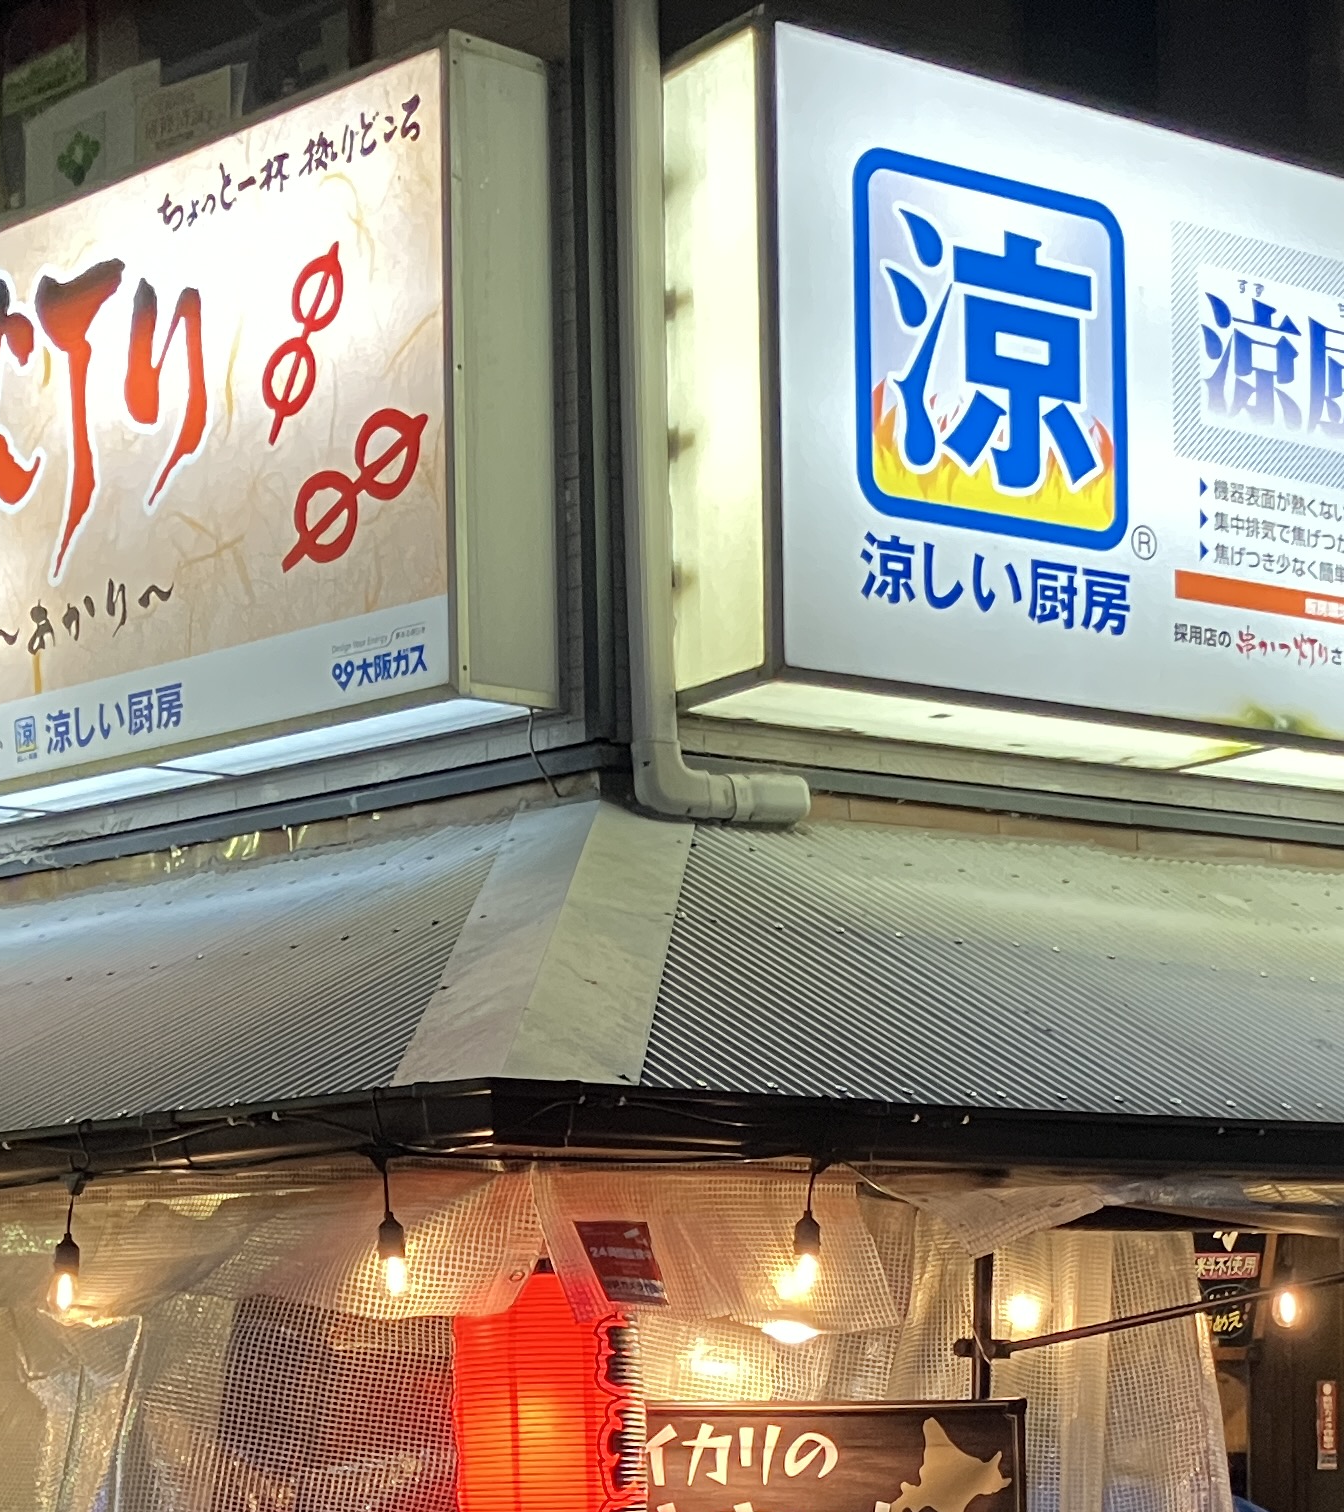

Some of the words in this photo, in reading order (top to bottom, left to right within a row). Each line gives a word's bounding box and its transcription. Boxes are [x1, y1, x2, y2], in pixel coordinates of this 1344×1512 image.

[882, 208, 1099, 489] 涼
[859, 532, 1133, 637] 涼しい厨房
[356, 643, 428, 687] 大阪ガス
[45, 682, 185, 755] 涼しい厨房
[642, 1423, 839, 1487] イカリの
